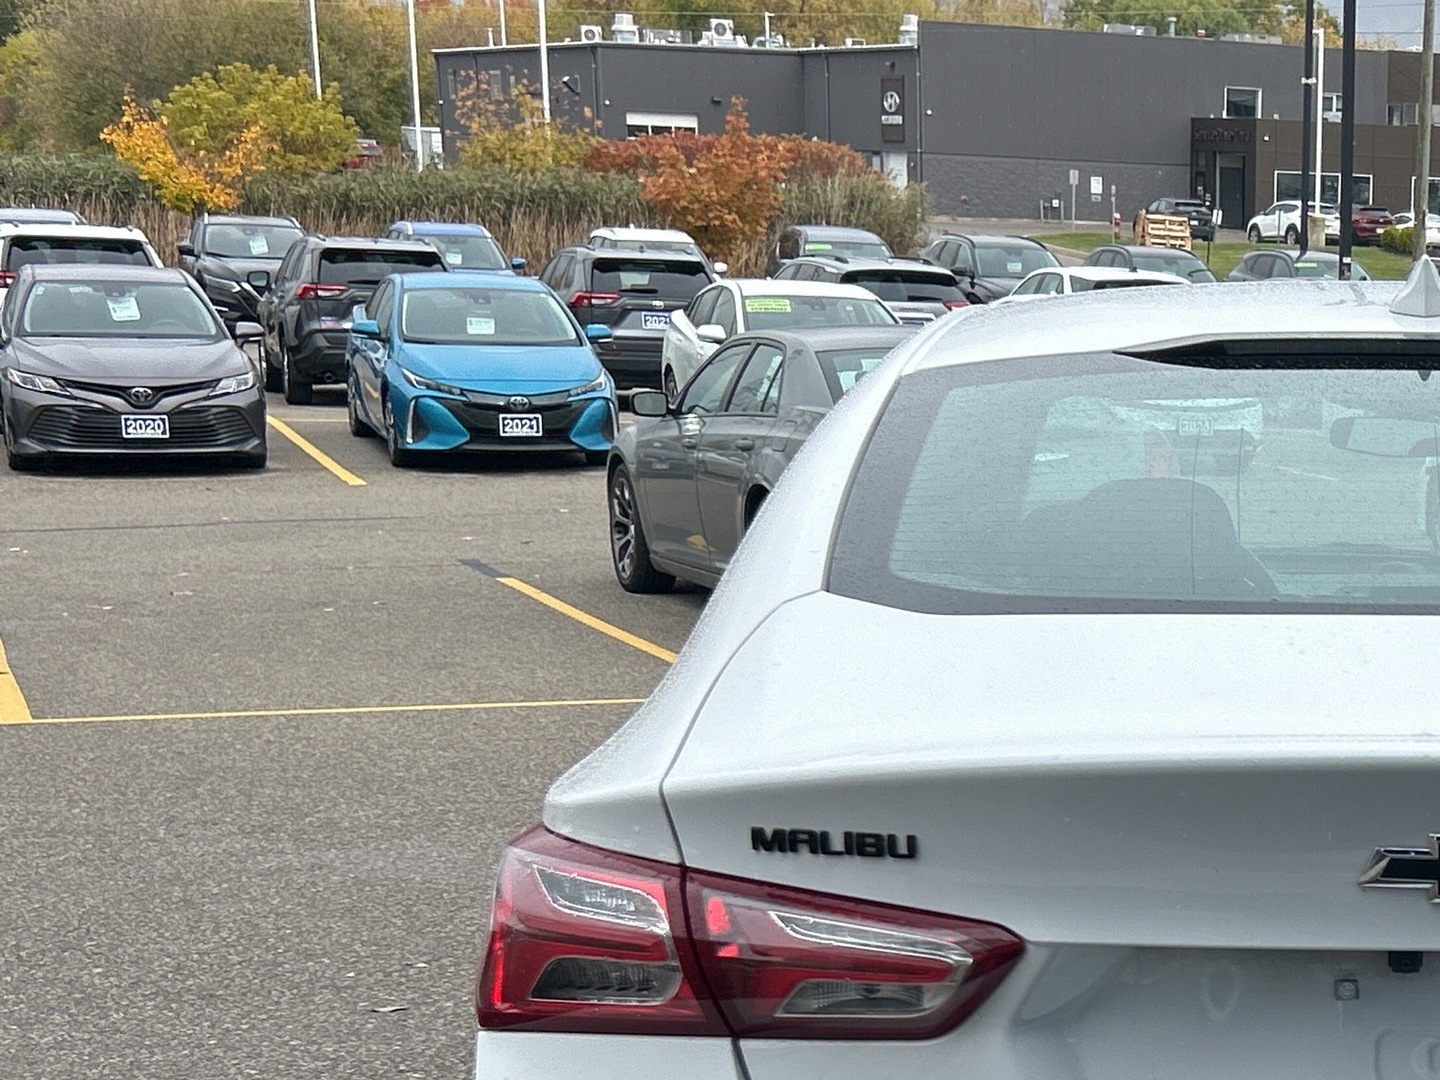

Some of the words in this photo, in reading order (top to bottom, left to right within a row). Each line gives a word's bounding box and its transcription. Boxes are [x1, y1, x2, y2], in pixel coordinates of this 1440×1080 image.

[126, 419, 164, 434] 2020
[503, 419, 538, 432] 2021
[751, 826, 917, 858] MALIBU
